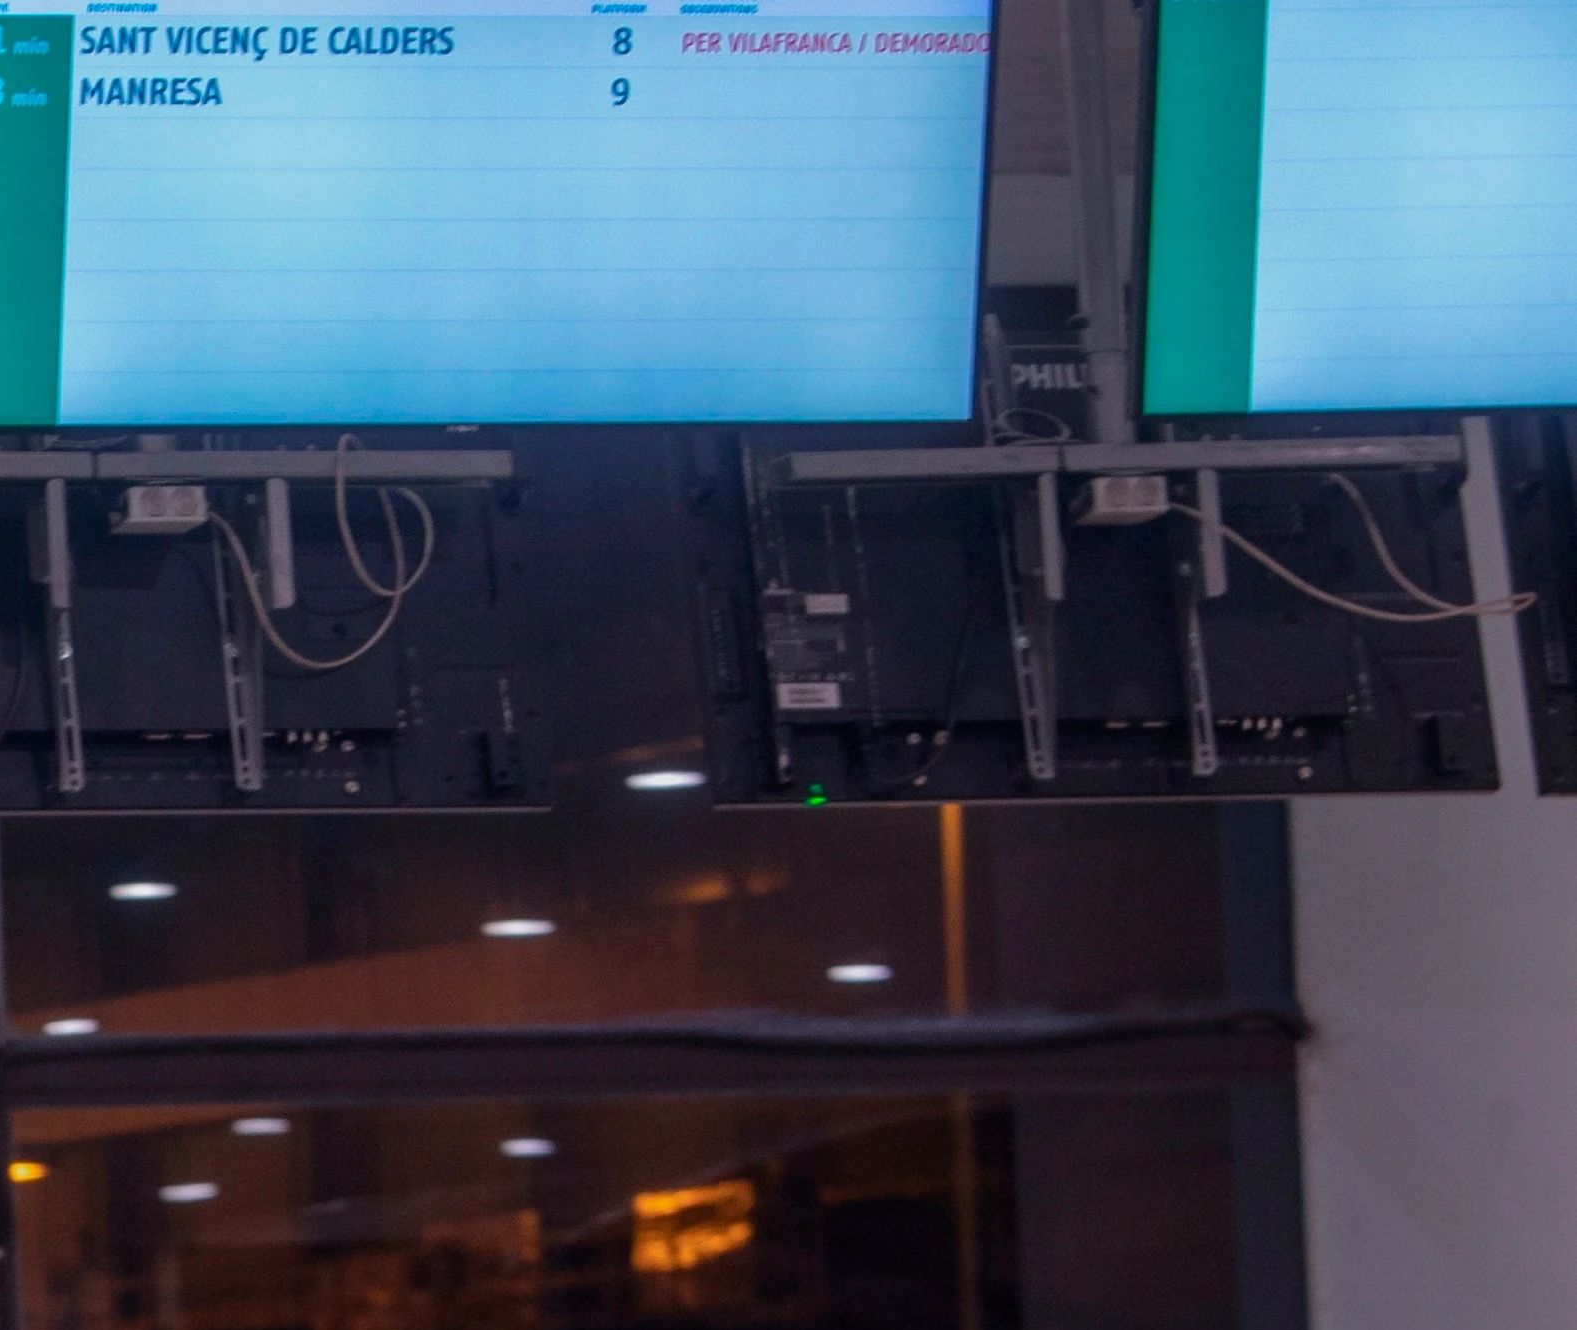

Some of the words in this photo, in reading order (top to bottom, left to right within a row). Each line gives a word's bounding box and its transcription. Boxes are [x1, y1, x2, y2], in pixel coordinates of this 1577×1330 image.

[79, 26, 157, 55] SANT
[166, 26, 269, 61] VICENÇ
[279, 26, 318, 54] DE
[327, 26, 456, 56] CALDERS
[612, 26, 634, 56] 8
[681, 32, 722, 54] PER
[728, 32, 851, 54] VILAFRANCA
[78, 77, 223, 106] MANRESA
[610, 77, 632, 107] 9
